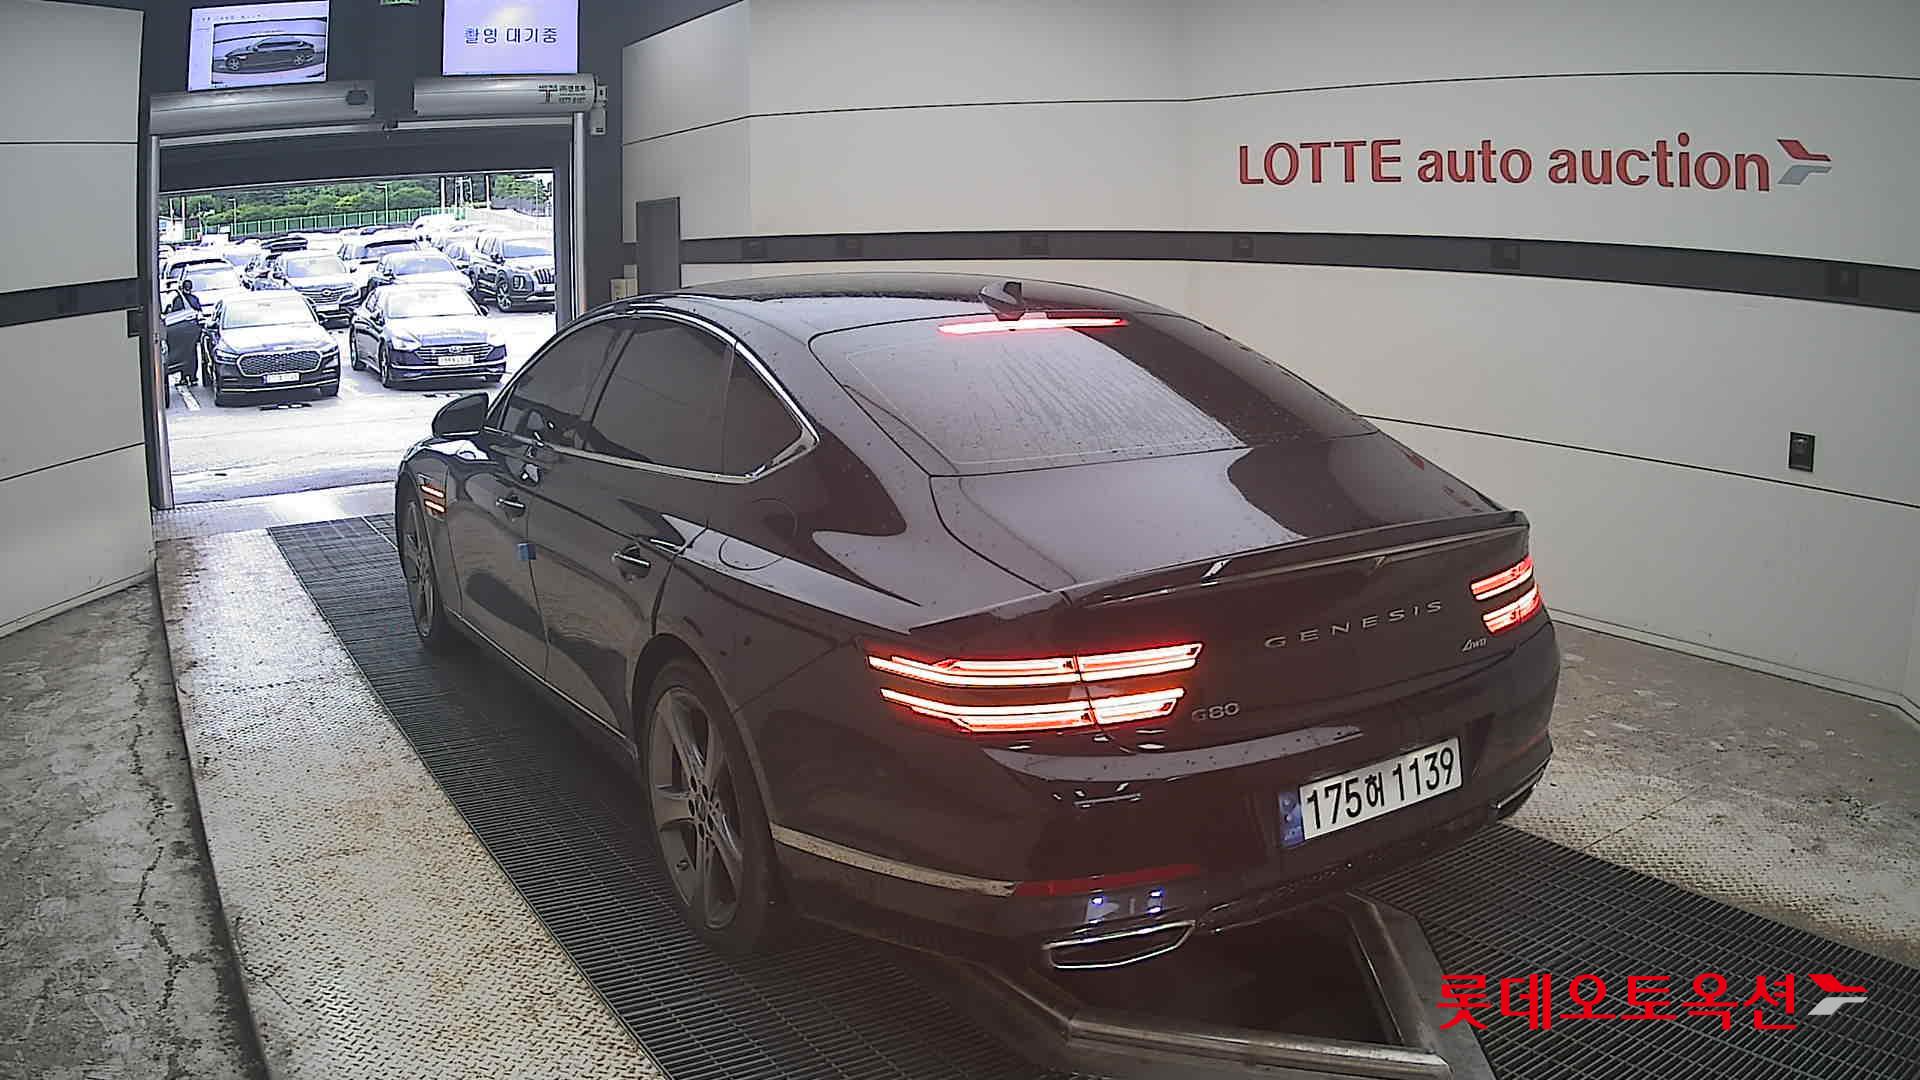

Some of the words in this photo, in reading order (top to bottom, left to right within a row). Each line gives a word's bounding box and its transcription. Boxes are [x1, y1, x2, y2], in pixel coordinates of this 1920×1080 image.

[506, 27, 558, 44] 대기중
[1239, 139, 1401, 185] LOTTE
[1417, 140, 1532, 184] auto
[1548, 132, 1771, 192] auction
[1264, 600, 1442, 648] GENESIS
[1191, 702, 1240, 722] G80
[1307, 772, 1385, 829] 175허
[1392, 747, 1454, 801] 1139
